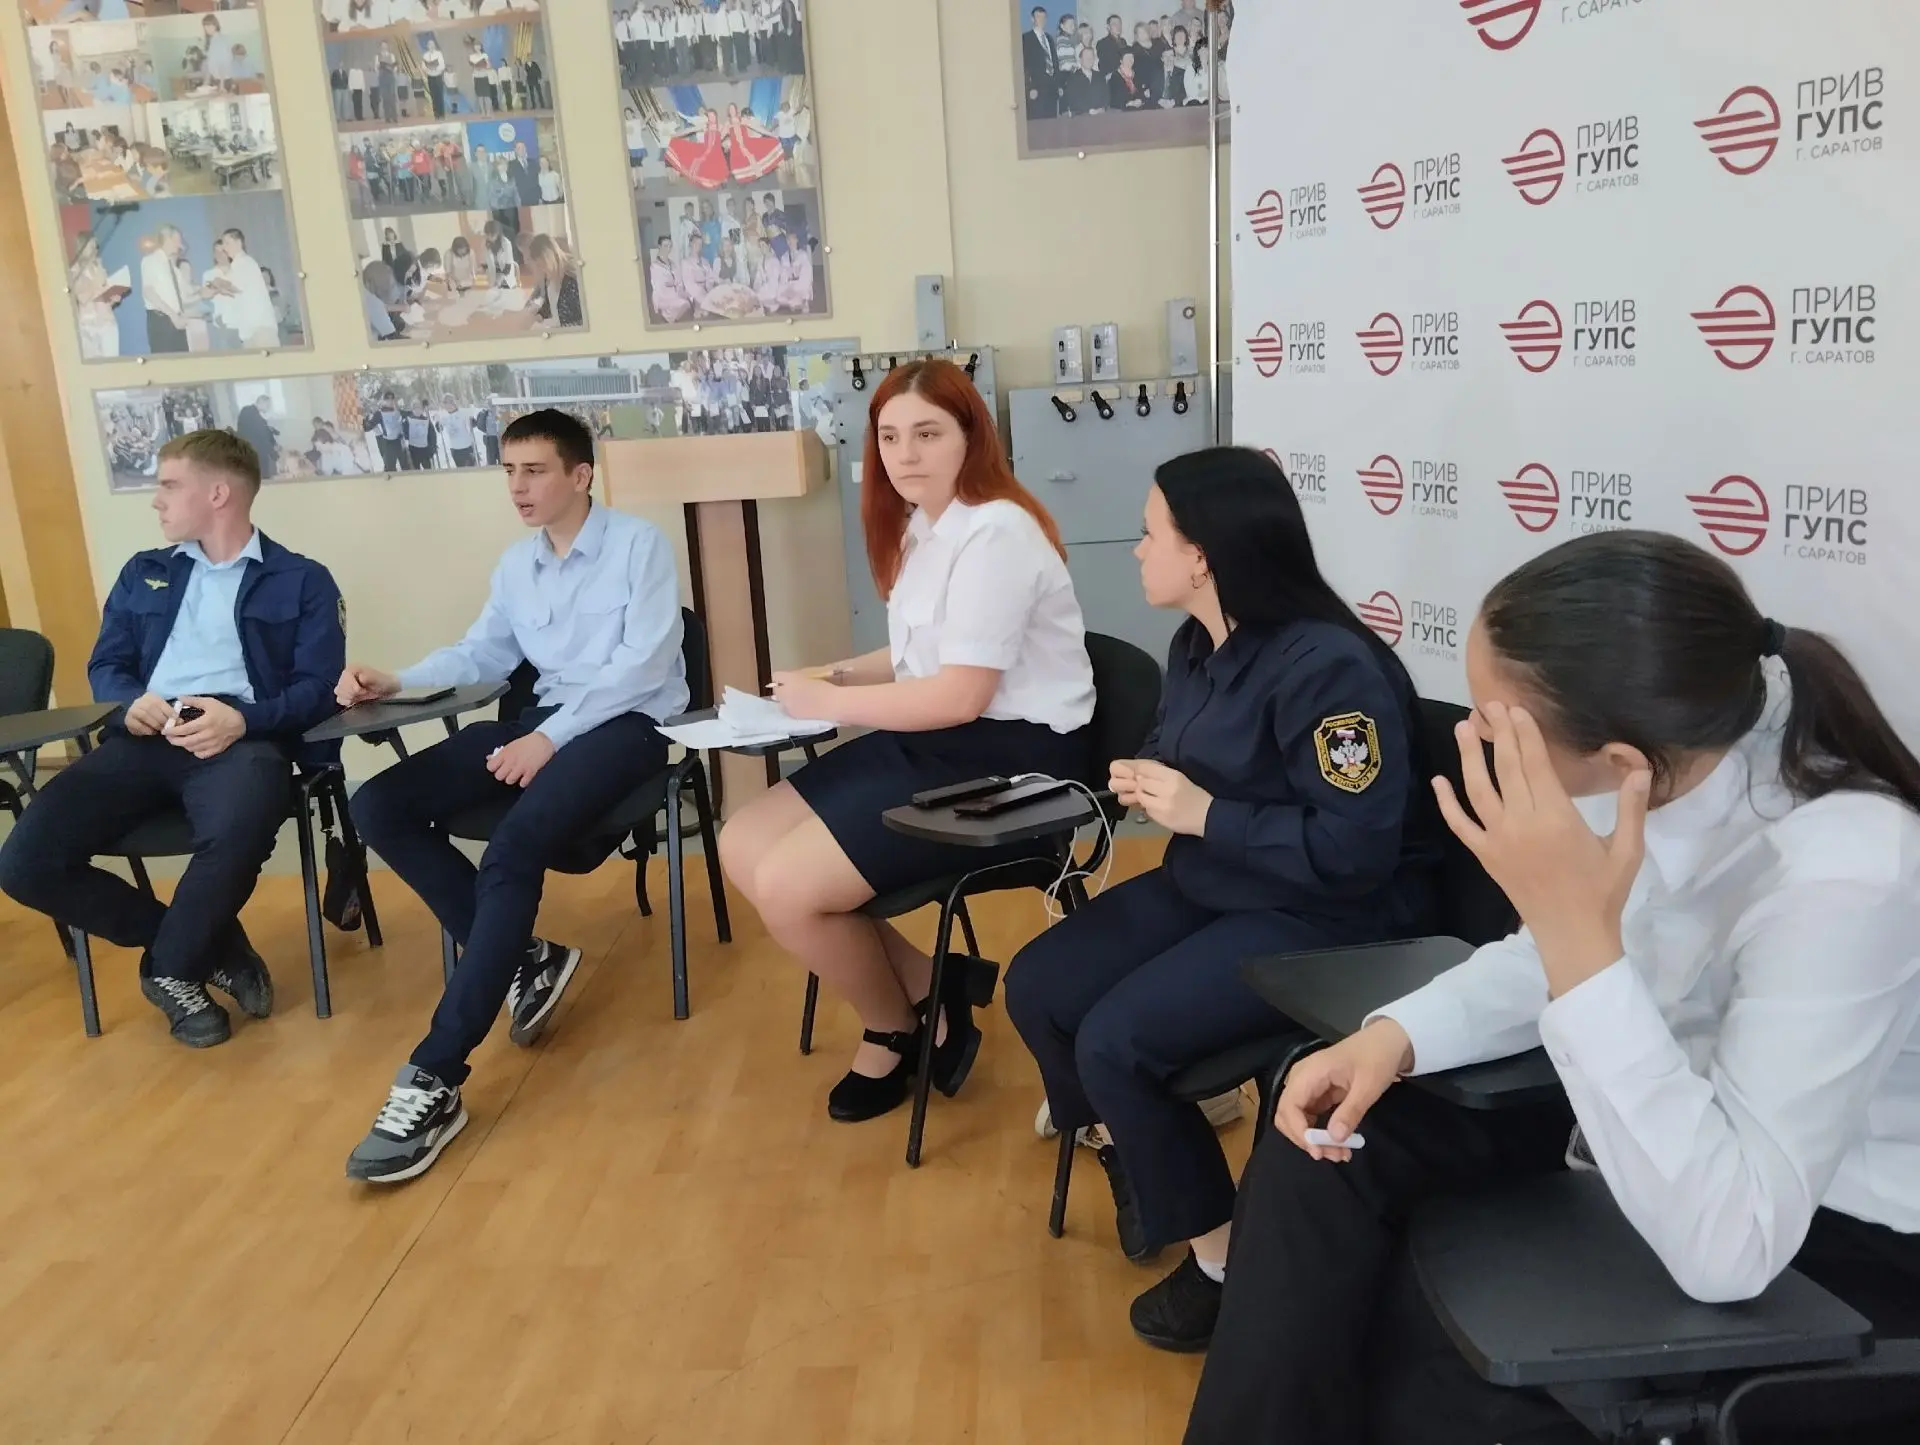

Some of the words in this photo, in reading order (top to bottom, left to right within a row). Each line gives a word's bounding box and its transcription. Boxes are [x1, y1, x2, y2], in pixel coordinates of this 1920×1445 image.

[1797, 67, 1883, 110] ПРИВ
[1577, 115, 1639, 150] ПРИВ
[1797, 100, 1883, 141] ГУПС
[1577, 143, 1639, 177] ГУПС
[1810, 136, 1883, 159] САРАТОВ
[1414, 152, 1461, 182] ПРИВ
[1290, 182, 1327, 208] ПРИВ
[1414, 176, 1461, 205] ГУПС
[1586, 173, 1639, 192] САРАТОВ
[1290, 203, 1326, 228] ГУПС
[1575, 299, 1636, 325] ПРИВ
[1793, 284, 1876, 314] ПРИВ
[1290, 321, 1326, 341] ПРИВ
[1412, 311, 1459, 334] ПРИВ
[1792, 316, 1876, 345] ГУПС
[1290, 342, 1326, 361] ГУПС
[1412, 335, 1459, 357] ГУПС
[1574, 326, 1636, 351] ГУПС
[1584, 354, 1636, 368] САРАТОВ
[1790, 351, 1801, 364] Г.
[1805, 350, 1875, 364] САРАТОВ
[1290, 452, 1326, 473] ПРИВ
[1412, 460, 1458, 482] ПРИВ
[1291, 472, 1326, 492] ГУПС
[1412, 482, 1458, 505] ГУПС
[1571, 470, 1632, 496] ПРИВ
[1571, 495, 1632, 522] ГУПС
[1785, 484, 1868, 516] ПРИВ
[1784, 513, 1868, 546] ГУПС
[1797, 545, 1867, 566] САРАТОВ
[1411, 600, 1457, 627] ПРИВ
[1412, 621, 1457, 648] ГУПС
